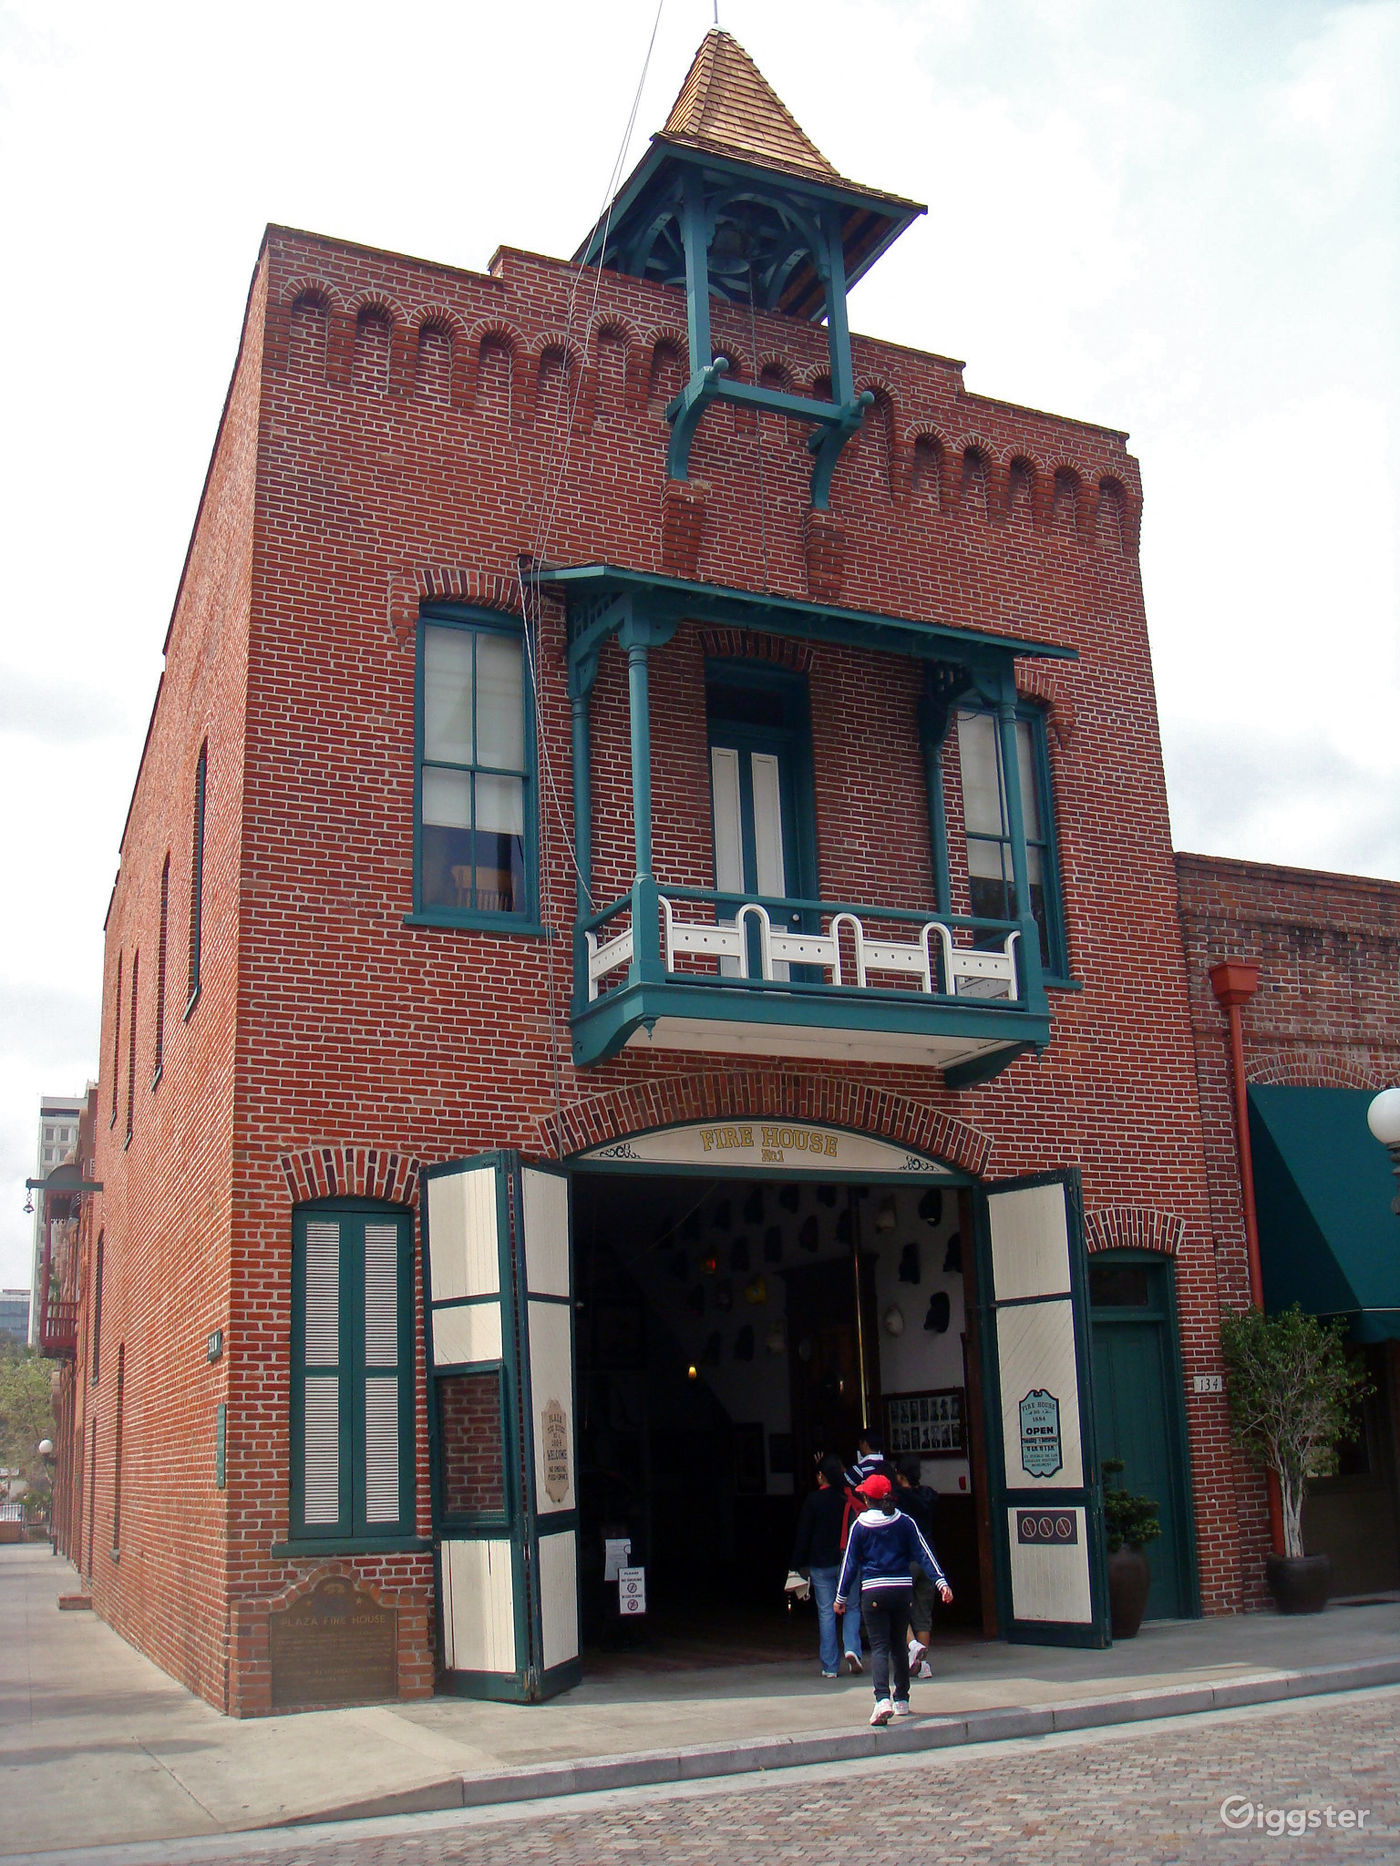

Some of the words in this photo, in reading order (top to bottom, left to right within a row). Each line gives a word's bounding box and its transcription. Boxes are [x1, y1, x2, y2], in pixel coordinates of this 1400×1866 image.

[700, 1127, 754, 1151] FIRE
[761, 1127, 838, 1157] HOUSE
[1200, 1378, 1218, 1391] 134
[1026, 1426, 1054, 1435] OPEN
[352, 1614, 386, 1624] HOUSE
